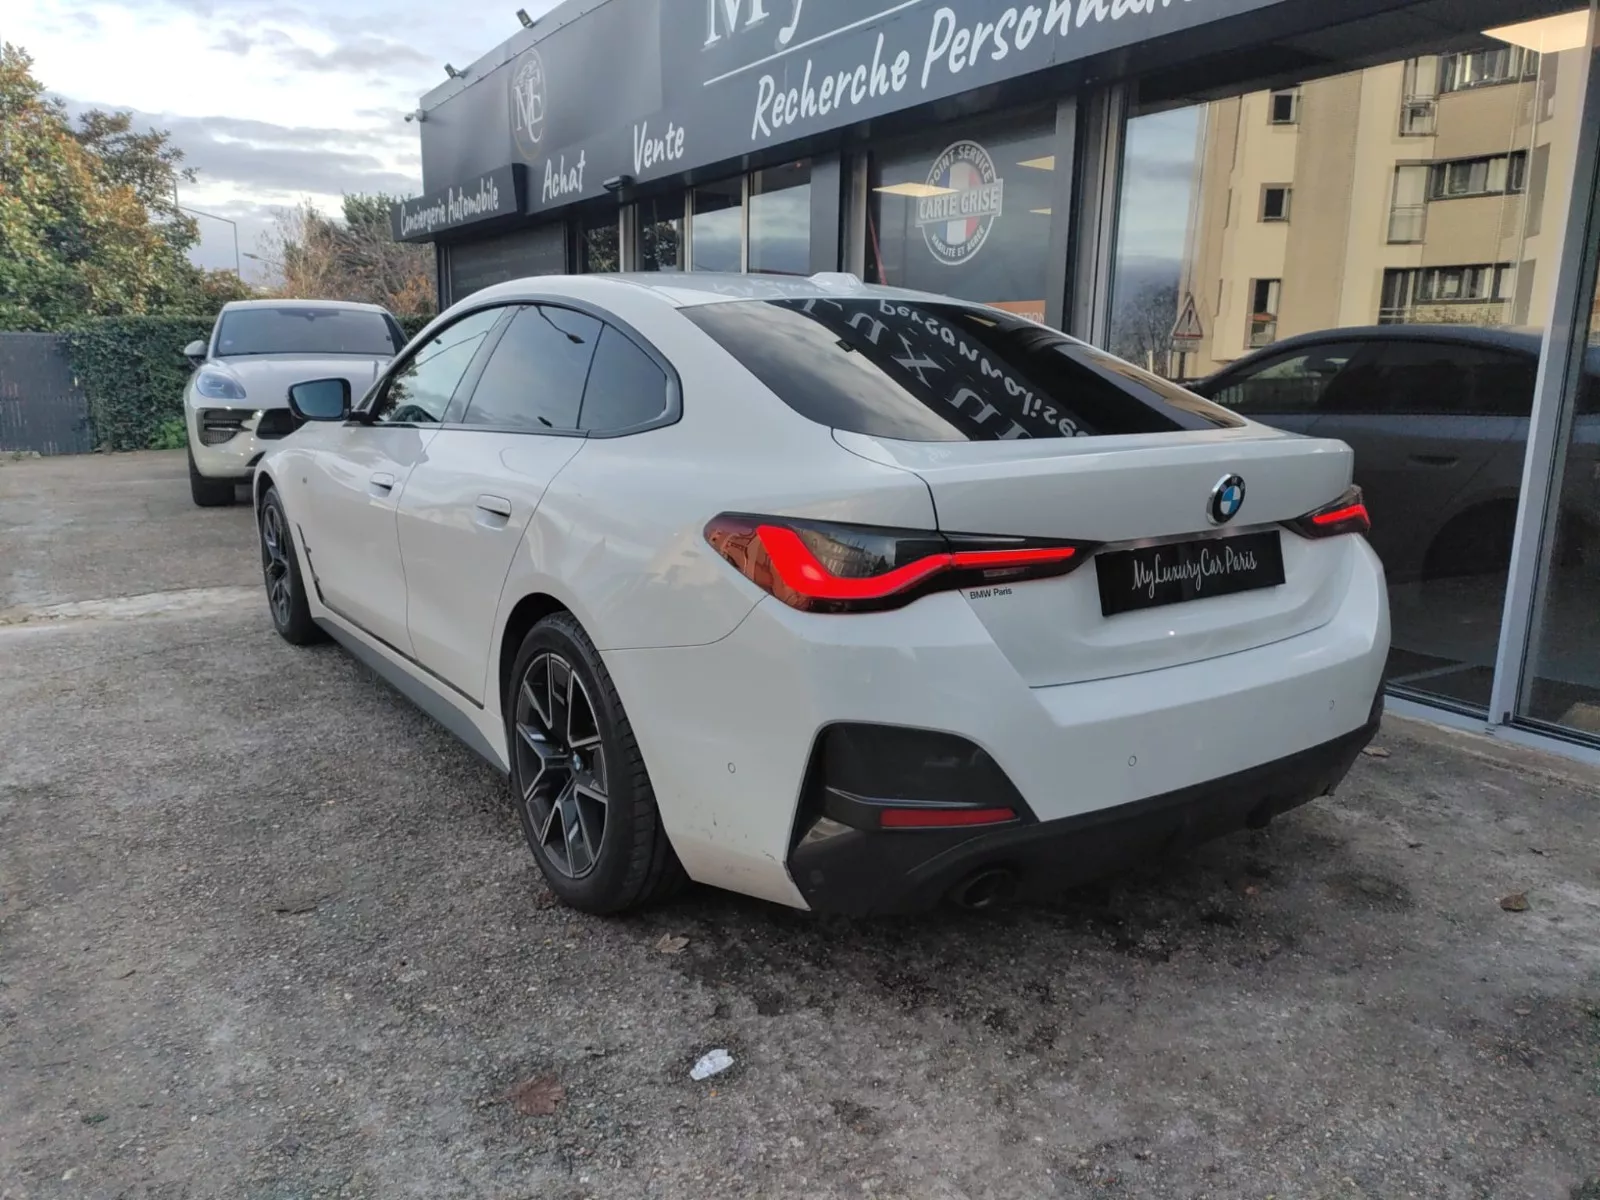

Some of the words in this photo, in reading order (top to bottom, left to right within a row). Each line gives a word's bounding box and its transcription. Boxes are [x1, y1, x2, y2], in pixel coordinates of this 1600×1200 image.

[751, 32, 910, 141] Recherche
[633, 120, 685, 176] Vente
[958, 145, 993, 183] SERVICE
[542, 149, 586, 204] Achat
[400, 199, 447, 237] Conciergerie
[448, 176, 500, 224] Automobile
[919, 195, 957, 219] CARTE
[960, 186, 998, 214] GRISE
[957, 246, 966, 257] ET
[970, 589, 991, 600] BMW
[993, 586, 1013, 596] Paris
